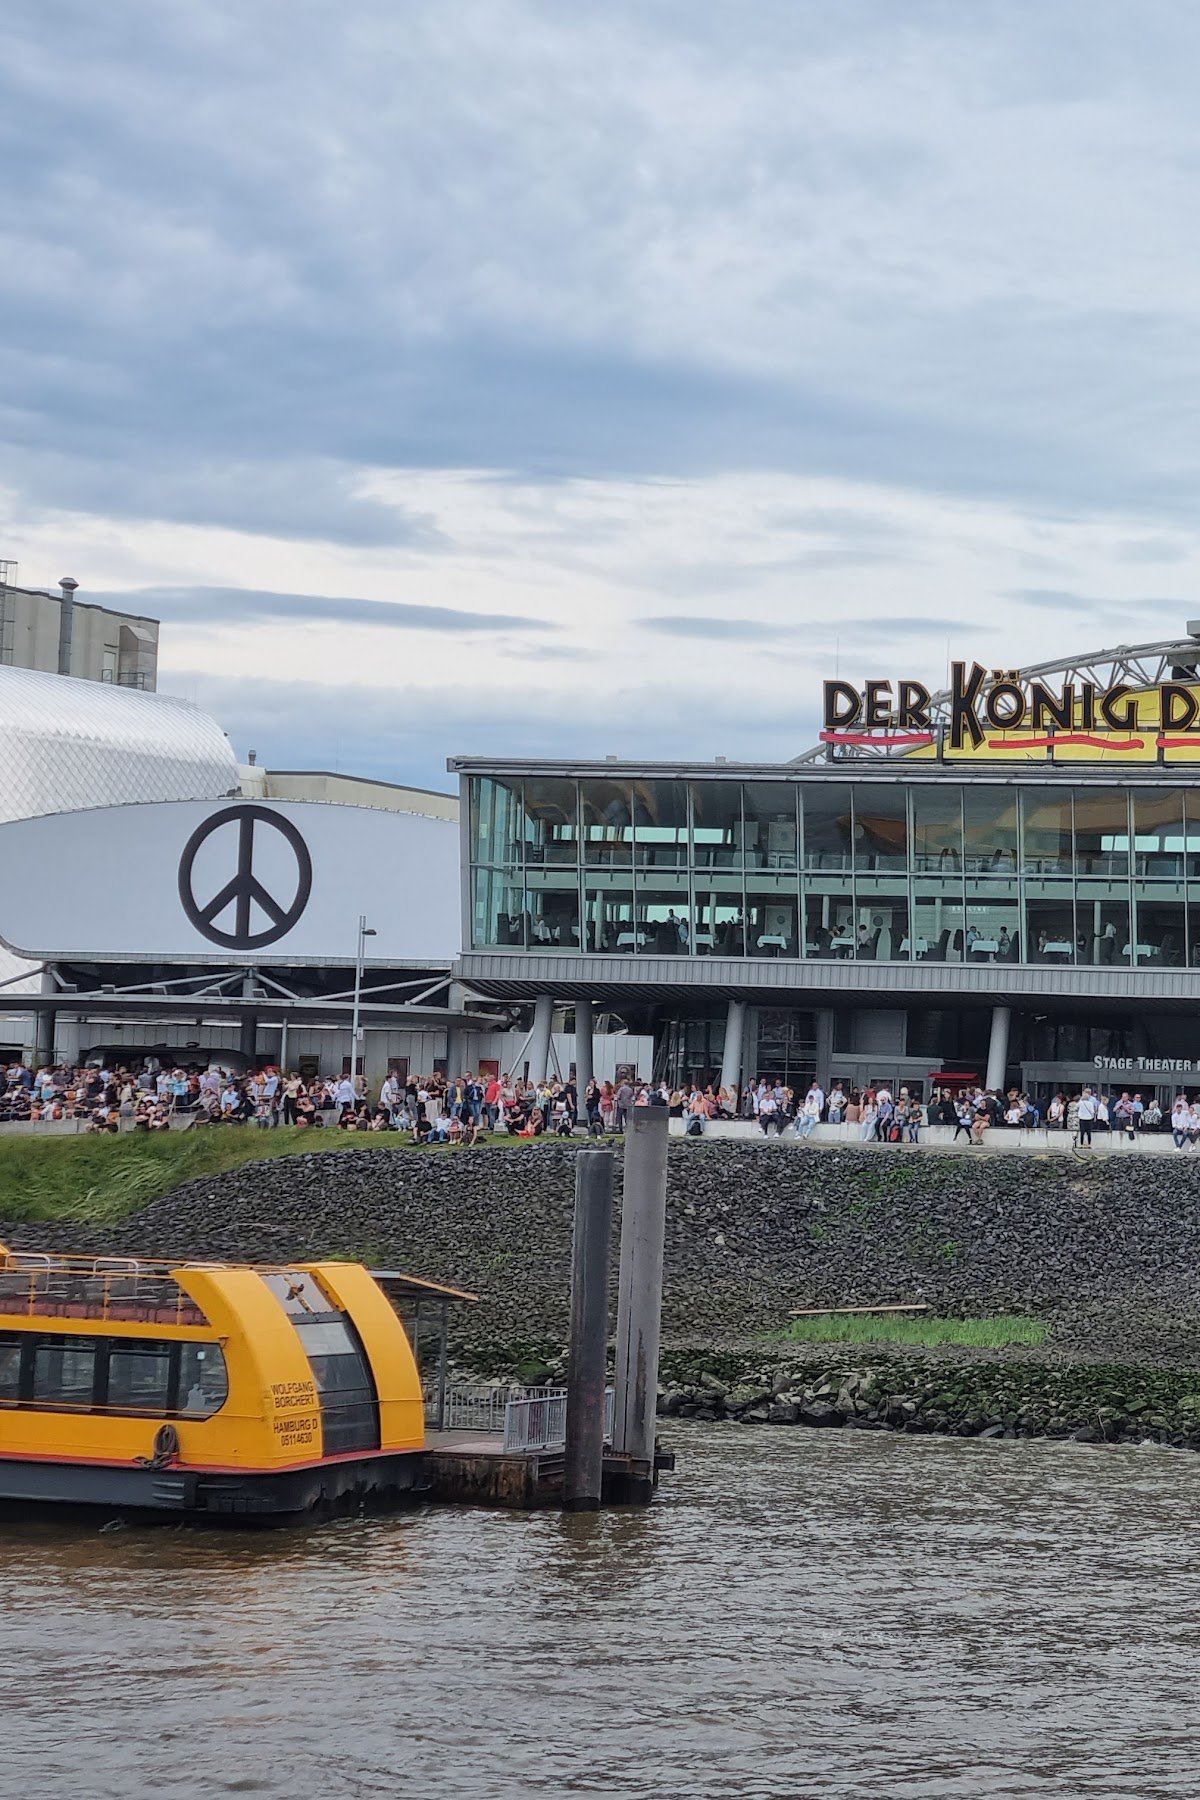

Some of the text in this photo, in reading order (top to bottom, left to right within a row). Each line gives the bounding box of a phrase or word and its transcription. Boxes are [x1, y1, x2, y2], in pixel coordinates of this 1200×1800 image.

[823, 680, 932, 730] DER
[949, 661, 1139, 750] KÖNIG
[1094, 1055, 1133, 1070] STAGE
[1137, 1056, 1192, 1071] THEATER
[271, 1381, 314, 1395] WOLFGANG
[274, 1394, 314, 1408] BORCHERT
[273, 1418, 318, 1434] HAMBURG D
